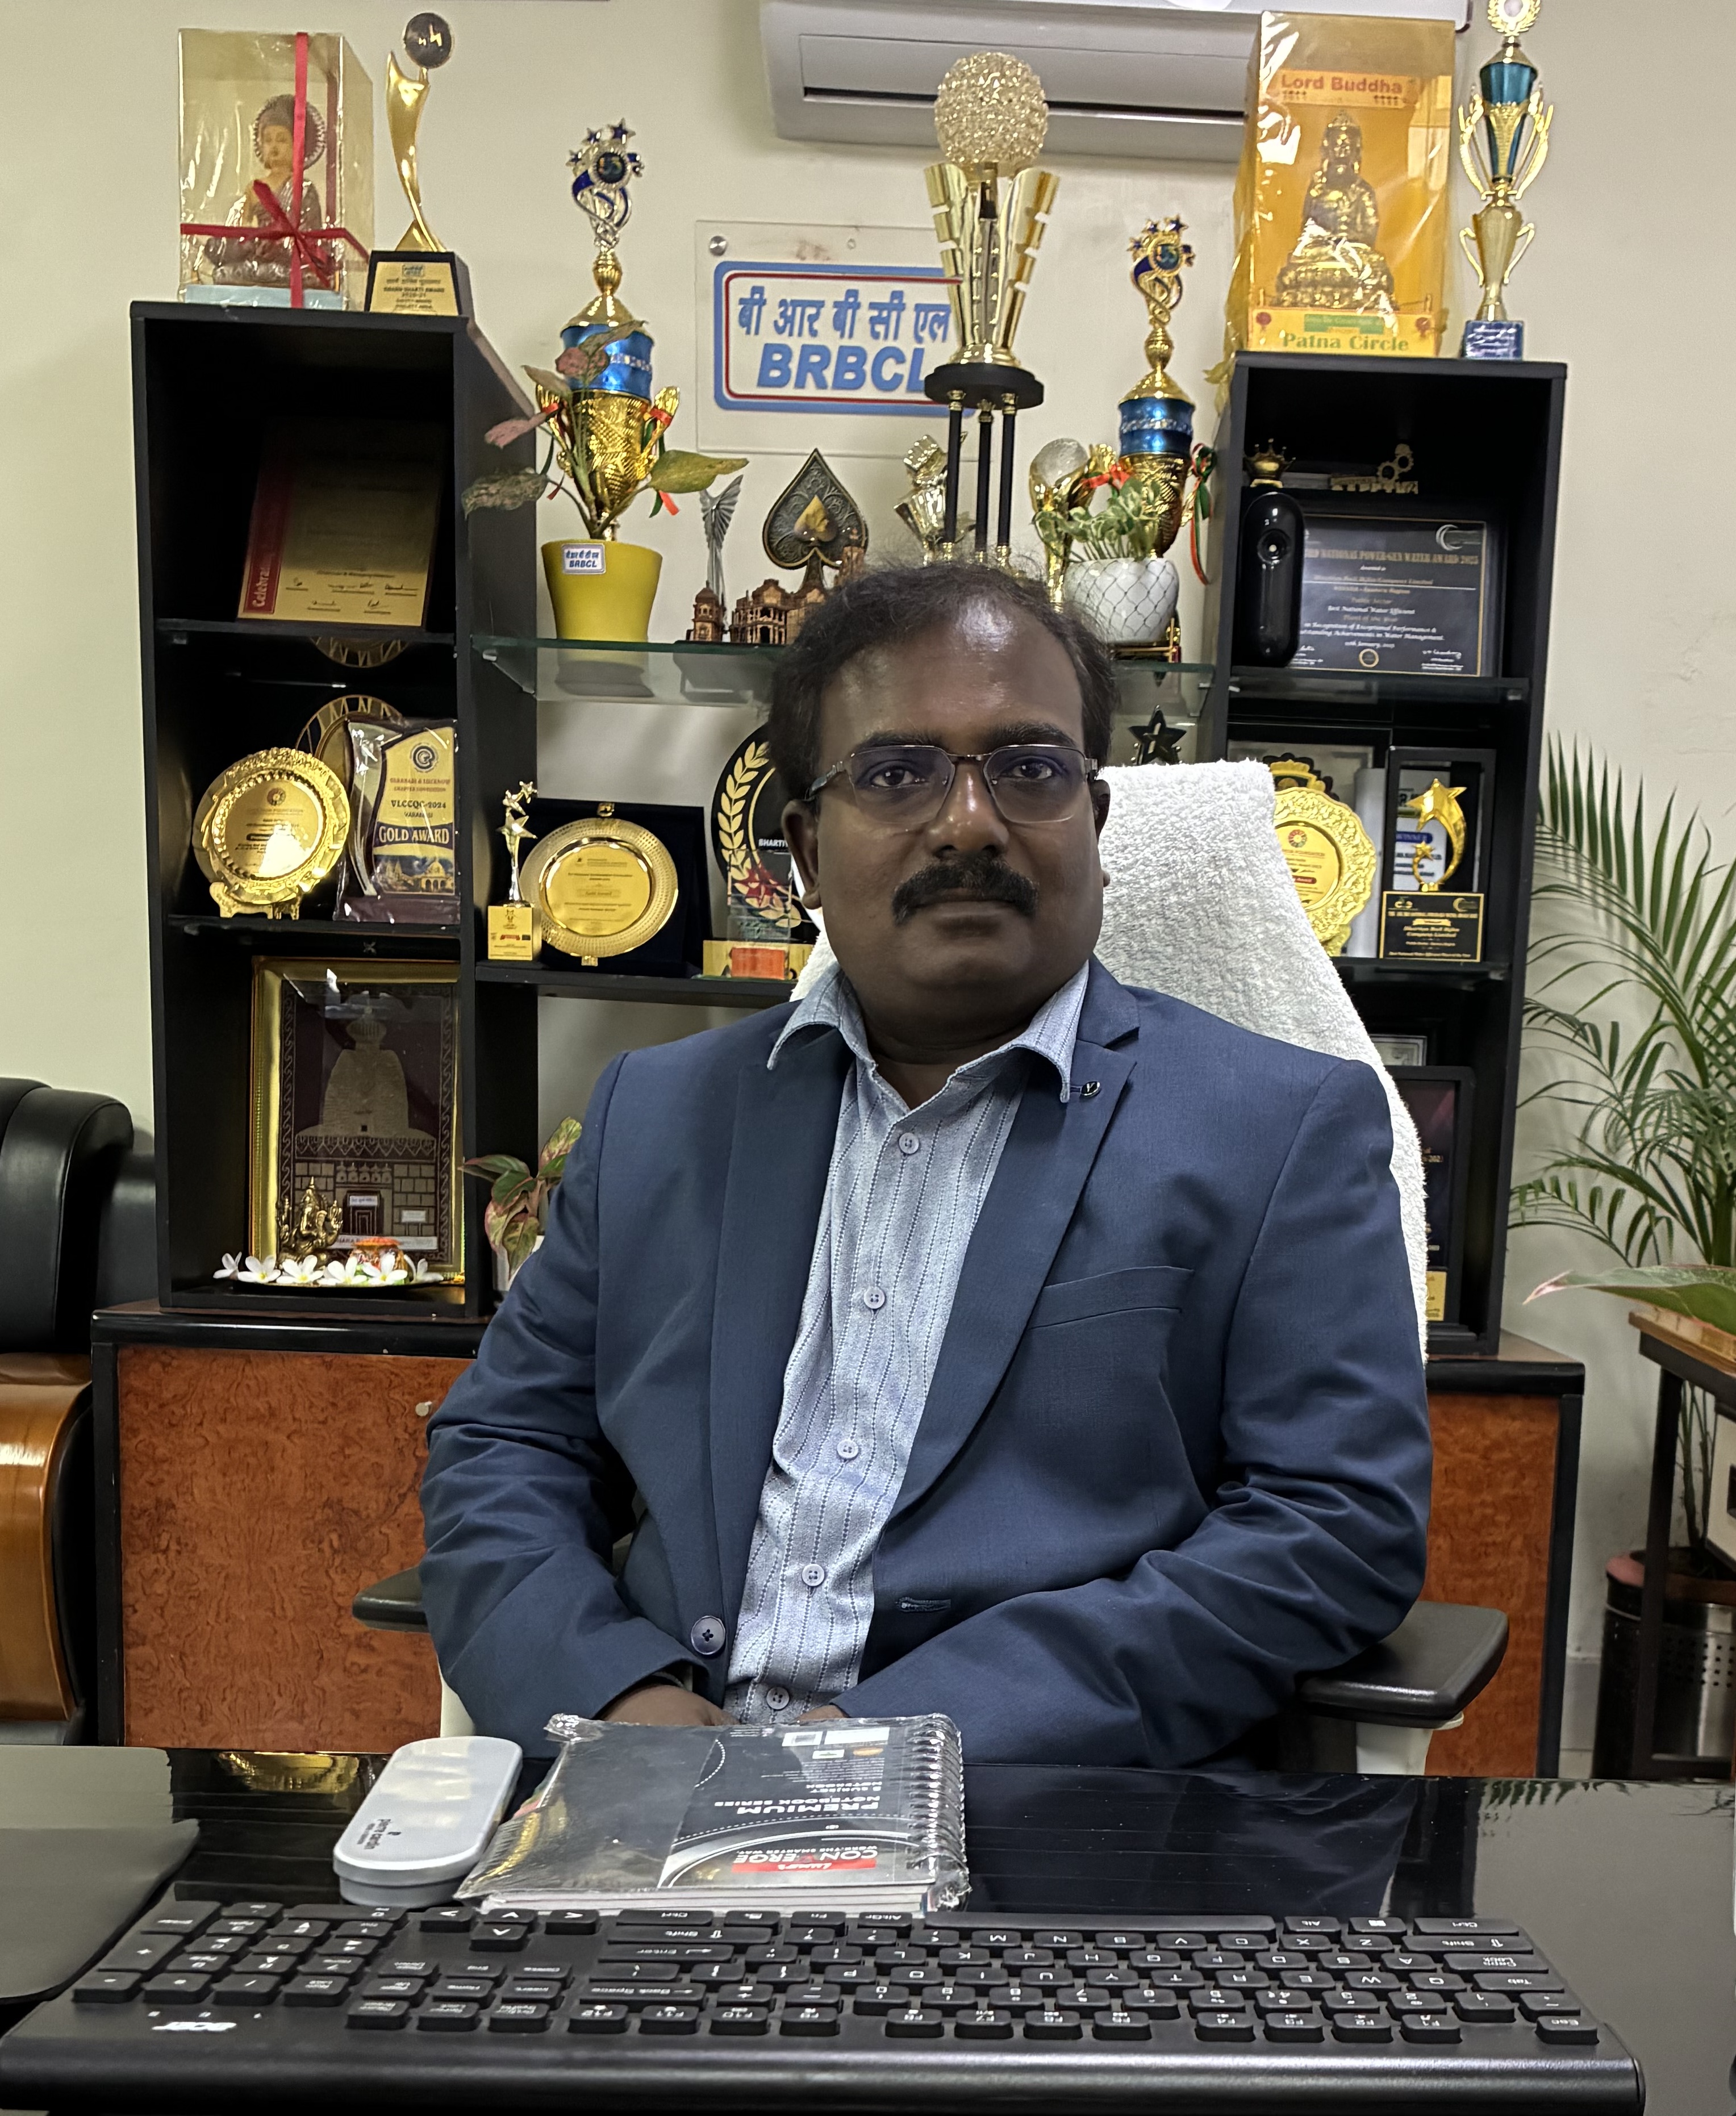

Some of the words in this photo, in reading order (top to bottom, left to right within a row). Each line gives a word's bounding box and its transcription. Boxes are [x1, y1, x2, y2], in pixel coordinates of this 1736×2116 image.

[1282, 74, 1324, 89] Lord
[1332, 77, 1403, 93] Buddha
[738, 286, 766, 336] बी
[774, 298, 825, 338] आर
[833, 289, 860, 339] बी
[869, 291, 905, 341] सी
[914, 303, 950, 343] एल
[1283, 333, 1341, 349] Patna
[1349, 336, 1409, 350] Circle
[757, 343, 927, 393] BRBCL
[379, 826, 408, 842] GOLD
[412, 829, 449, 844] AWARD
[736, 1802, 879, 1814] PREMIUM
